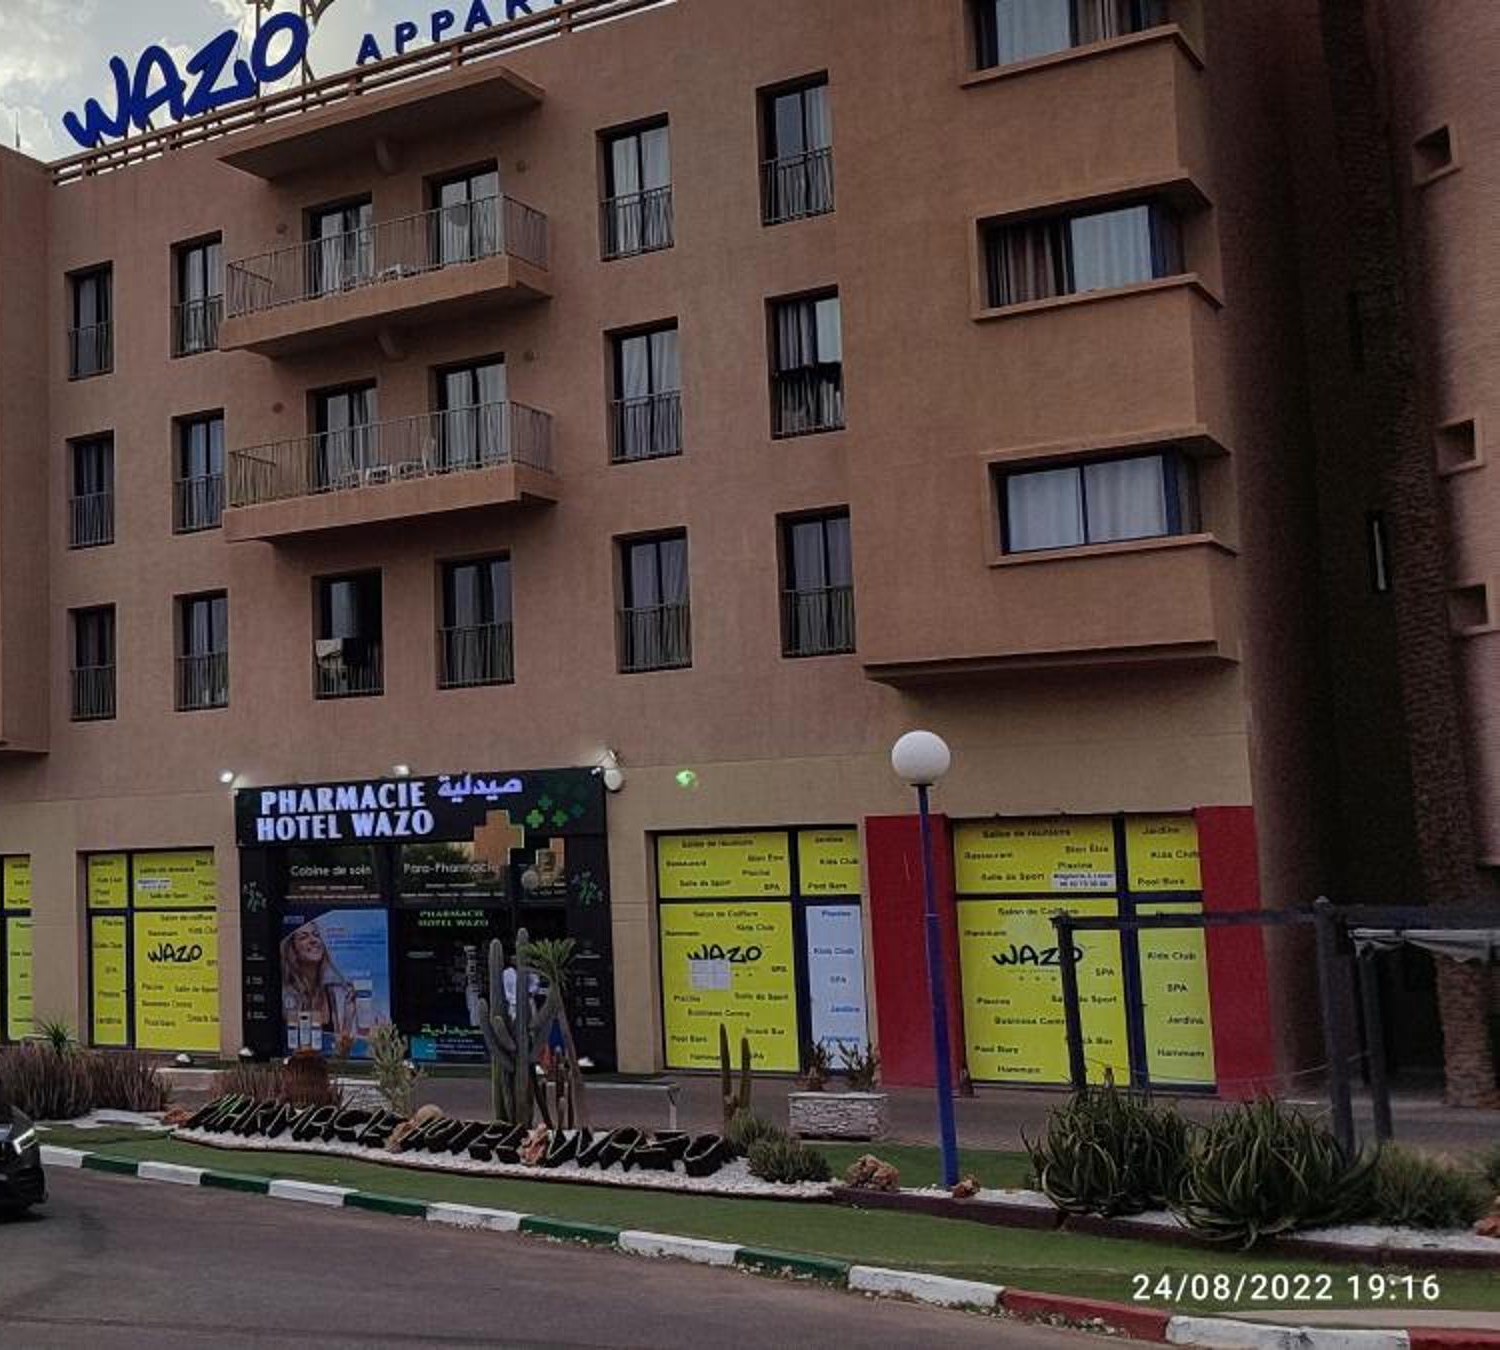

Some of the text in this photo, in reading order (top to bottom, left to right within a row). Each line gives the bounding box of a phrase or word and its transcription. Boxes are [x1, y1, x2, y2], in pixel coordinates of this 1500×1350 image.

[62, 0, 566, 148] WAZO APPAR
[261, 781, 428, 815] PHARMACIE
[437, 772, 523, 803] صيدلية
[257, 809, 435, 841] HOTEL WAZO
[148, 944, 202, 962] WAZO
[687, 944, 762, 964] WAZO
[1167, 984, 1188, 992] SPA
[543, 1126, 724, 1177] WAZO
